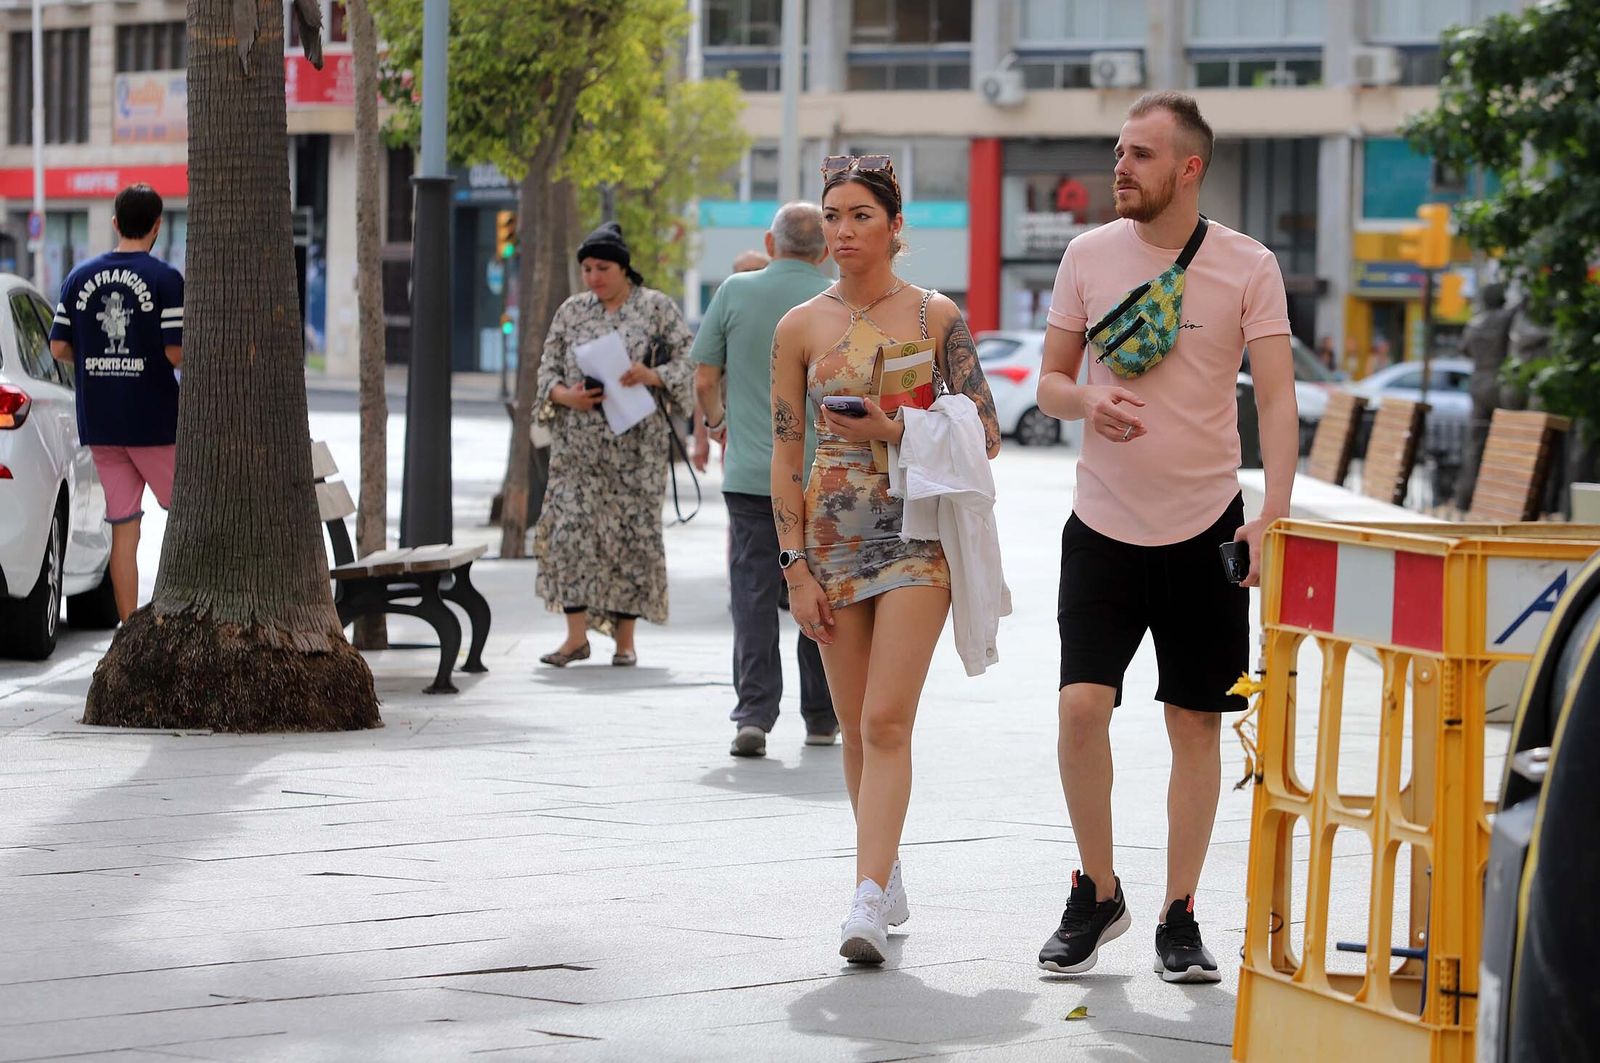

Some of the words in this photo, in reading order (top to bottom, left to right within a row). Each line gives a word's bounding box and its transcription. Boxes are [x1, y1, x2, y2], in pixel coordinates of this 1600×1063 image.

[76, 279, 96, 311] SAN
[94, 269, 154, 312] FRANCISCO
[85, 357, 121, 371] SPORTS
[121, 357, 144, 371] CLUB
